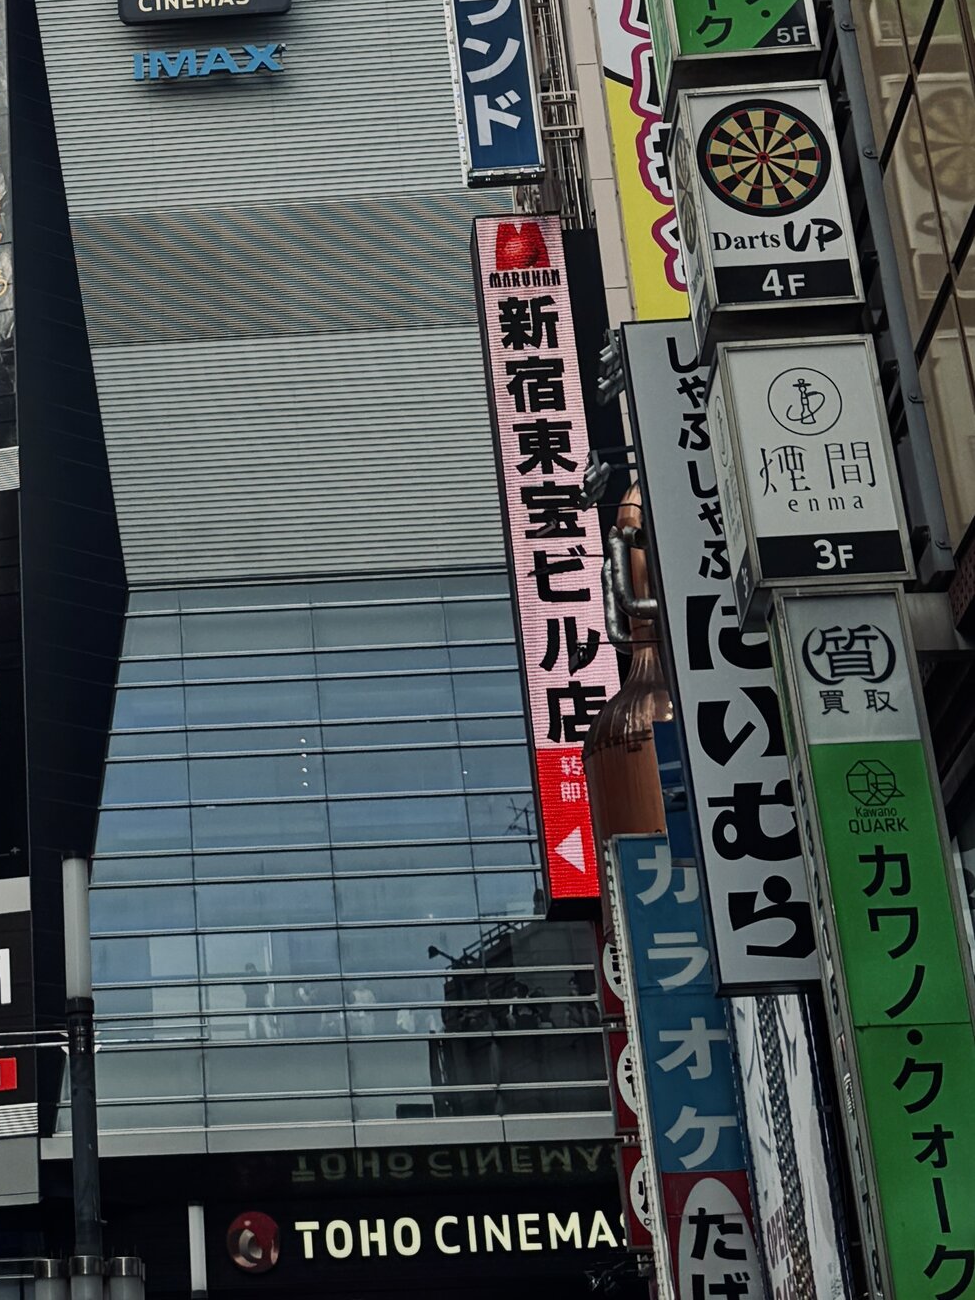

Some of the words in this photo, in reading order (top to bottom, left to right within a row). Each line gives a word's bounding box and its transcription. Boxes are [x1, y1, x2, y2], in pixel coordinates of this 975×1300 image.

[777, 26, 807, 44] 5F
[133, 43, 284, 81] IMAX
[713, 232, 780, 251] Darts
[489, 269, 561, 289] MARUHAN
[762, 269, 806, 298] 4F
[787, 495, 865, 514] enma
[499, 295, 607, 744] 新宿東宝ビル店
[814, 539, 855, 570] 3F
[819, 689, 899, 715] 買取
[854, 805, 898, 819] Kawano
[848, 817, 910, 835] QUARK
[636, 844, 738, 1170] カラオケ
[294, 1216, 422, 1260] TOHO
